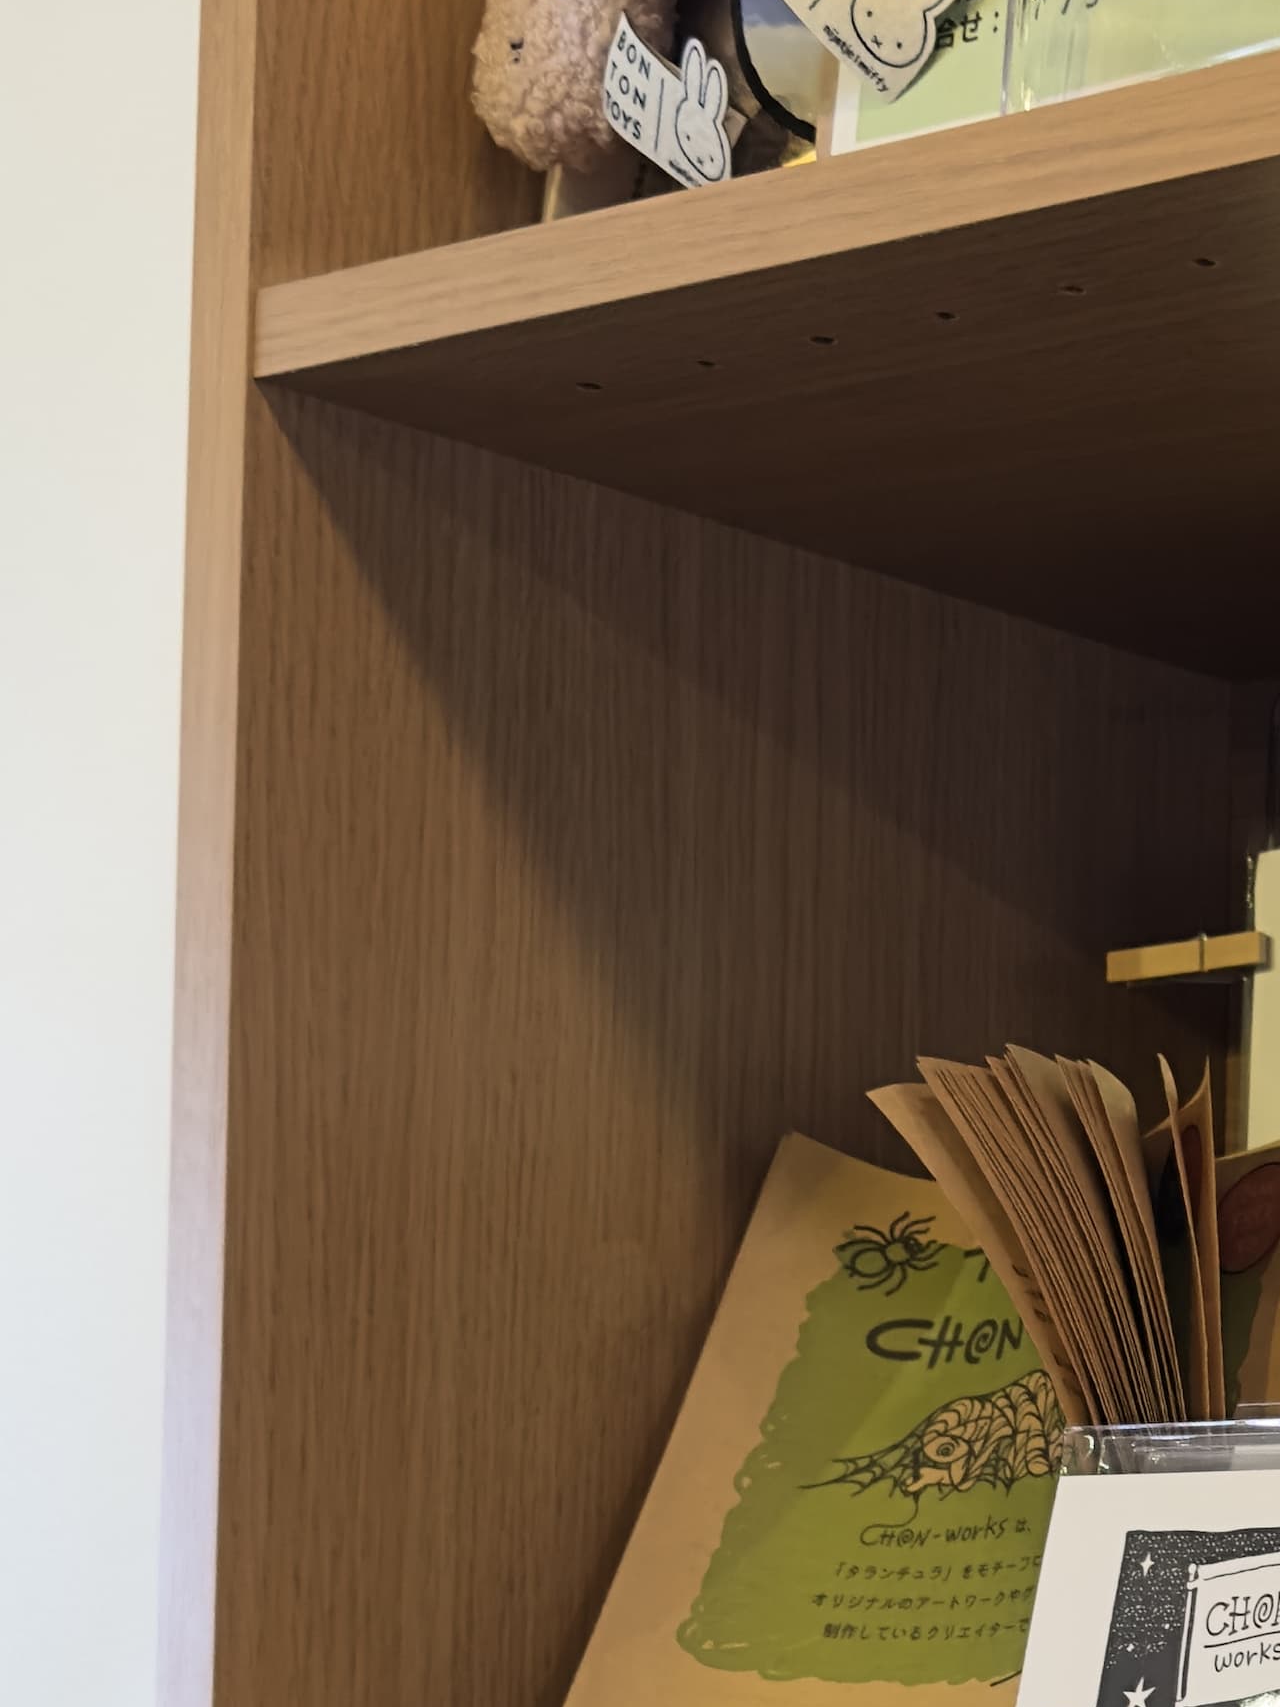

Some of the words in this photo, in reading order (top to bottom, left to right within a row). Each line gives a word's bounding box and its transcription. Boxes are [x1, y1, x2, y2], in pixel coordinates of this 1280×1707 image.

[616, 30, 652, 80] BON
[609, 63, 648, 111] TON
[605, 95, 644, 143] TOYS
